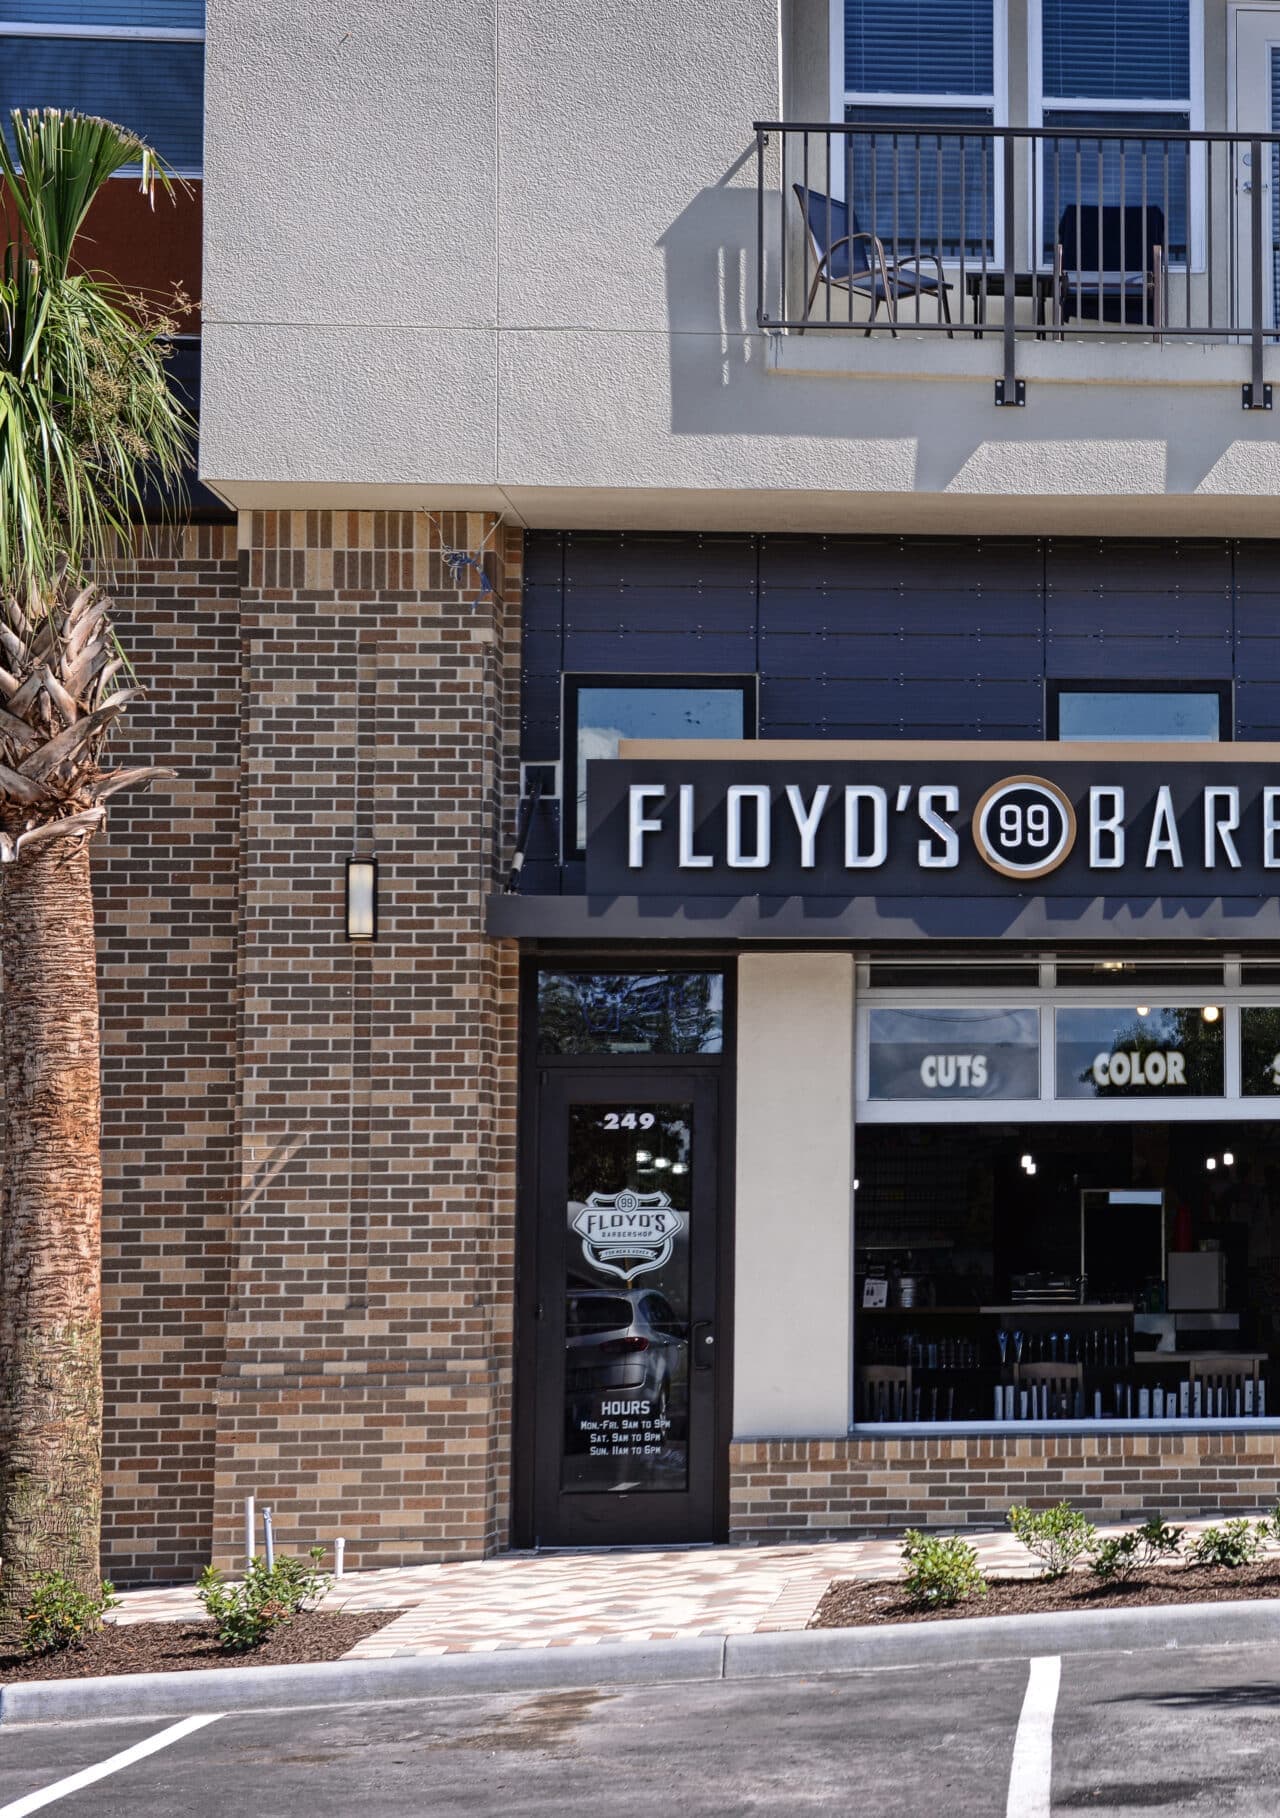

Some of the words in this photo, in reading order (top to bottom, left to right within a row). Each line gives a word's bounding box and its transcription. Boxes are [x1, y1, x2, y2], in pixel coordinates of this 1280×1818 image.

[628, 784, 960, 869] FLOYD'S
[999, 803, 1050, 848] 99
[920, 1055, 988, 1088] CUTS
[1093, 1050, 1187, 1086] COLOR
[603, 1112, 656, 1130] 249
[620, 1198, 634, 1209] 99
[587, 1214, 666, 1234] FLOYD'S
[601, 1230, 653, 1238] BARBERSHOP
[601, 1400, 651, 1416] HOURS
